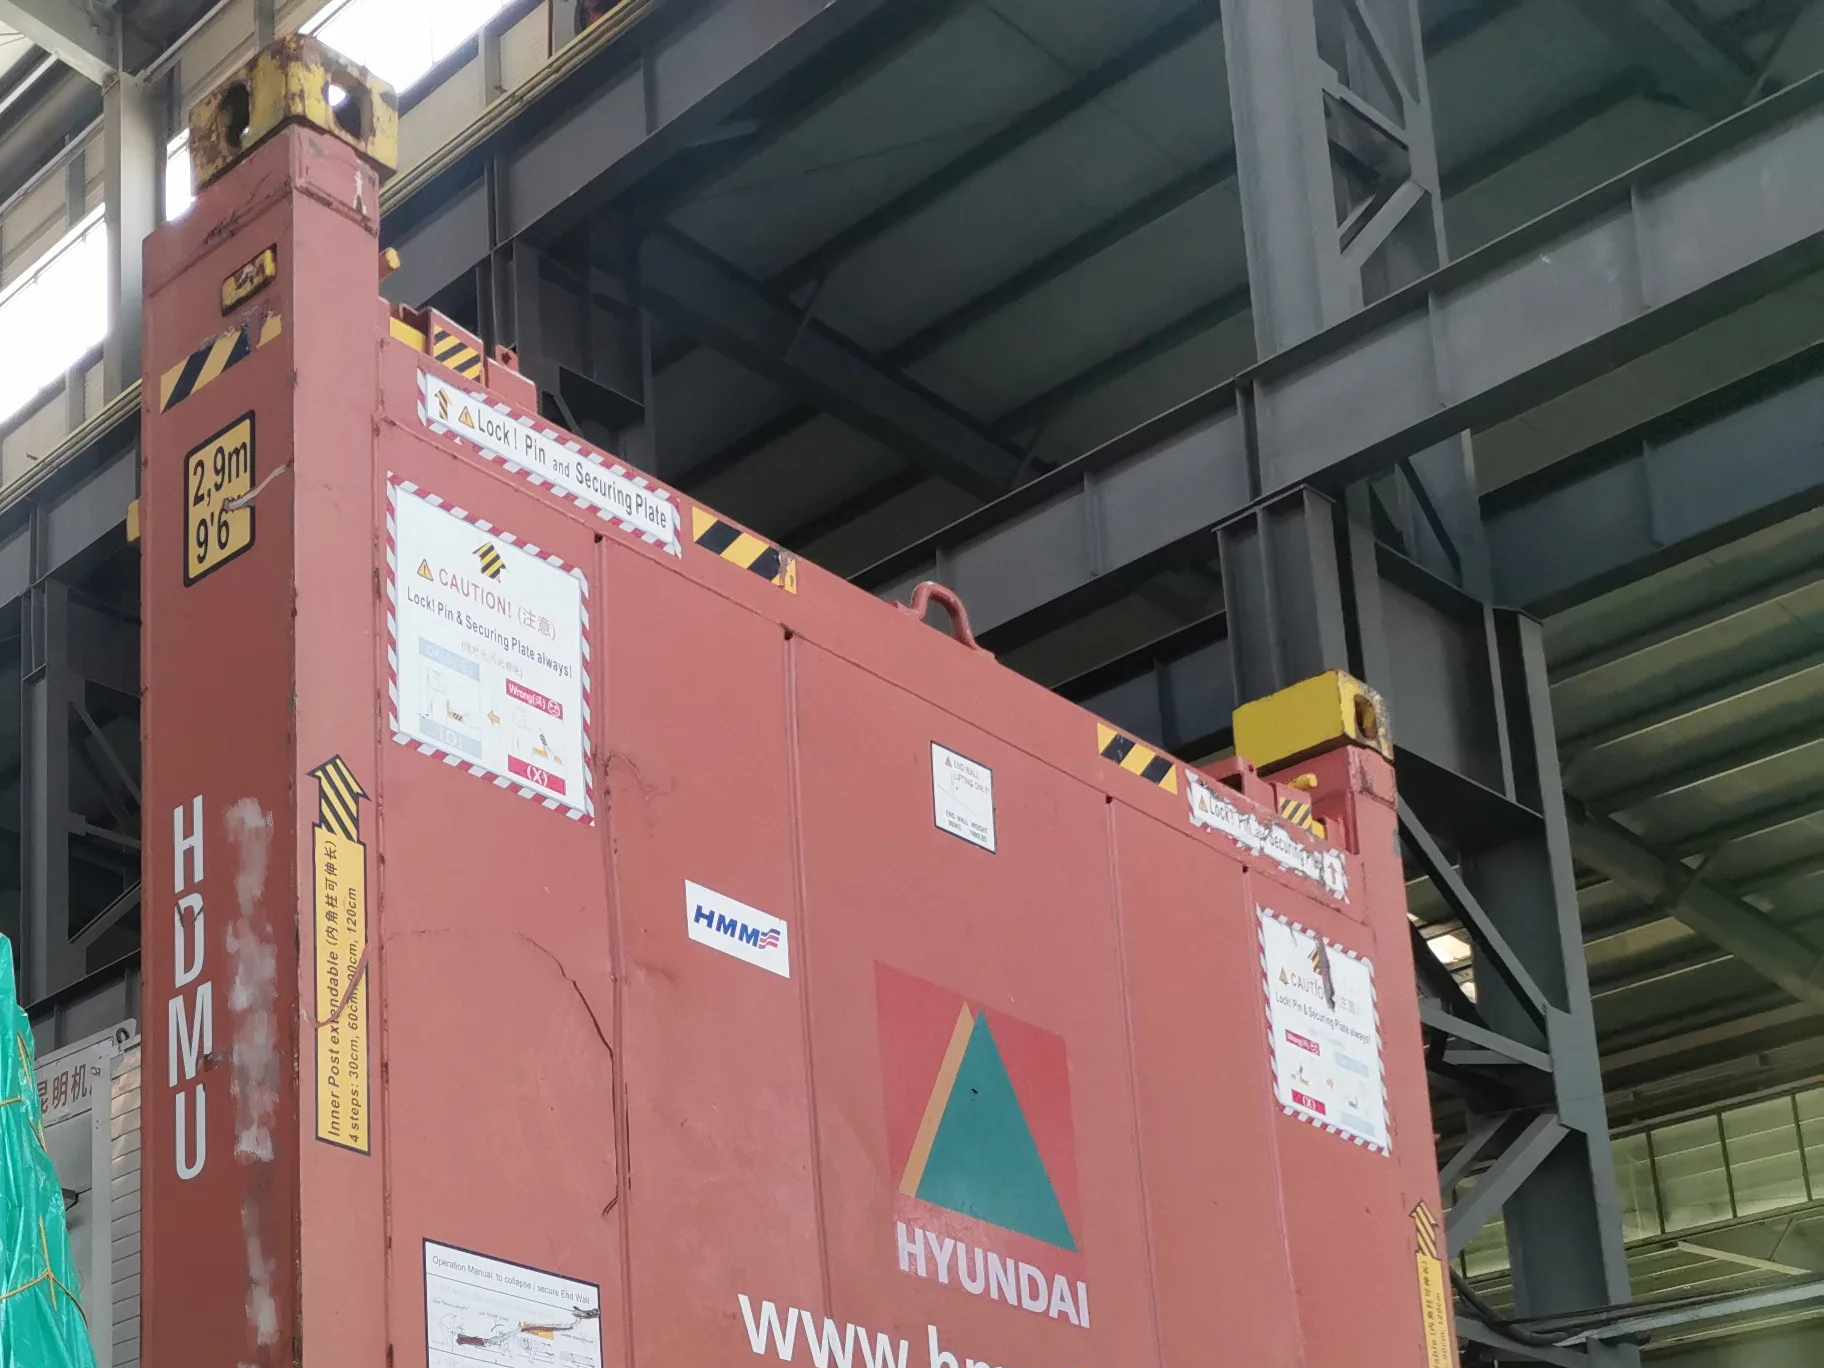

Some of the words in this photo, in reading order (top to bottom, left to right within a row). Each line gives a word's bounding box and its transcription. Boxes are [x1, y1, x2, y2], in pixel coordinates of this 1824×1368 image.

[477, 408, 517, 450] Lock!
[525, 434, 546, 465] Pin
[552, 457, 570, 479] and
[575, 461, 632, 516] Securing
[635, 492, 667, 529] Plate
[438, 568, 512, 618] CAUTION!
[407, 586, 435, 613] Lock!
[437, 602, 454, 621] Pin
[456, 611, 464, 626] &
[465, 615, 509, 651] Securing
[511, 637, 535, 661] Plate
[537, 650, 572, 679] always!
[346, 887, 357, 934] 120cm
[694, 904, 760, 948] HMM
[169, 794, 212, 1180] HDMU
[327, 1048, 340, 1089] Post
[348, 1035, 360, 1079] 30cm,
[37, 1064, 92, 1114] 昆明机
[350, 1083, 362, 1131] steps:
[328, 1092, 341, 1137] Inner
[348, 1134, 360, 1144] 4
[432, 1255, 466, 1272] Operation
[495, 1273, 503, 1283] to
[505, 1275, 532, 1291] collapse
[537, 1285, 560, 1297] secure
[561, 1290, 574, 1301] End
[575, 1292, 590, 1305] Wall
[895, 1219, 1090, 1330] HYUNDAI
